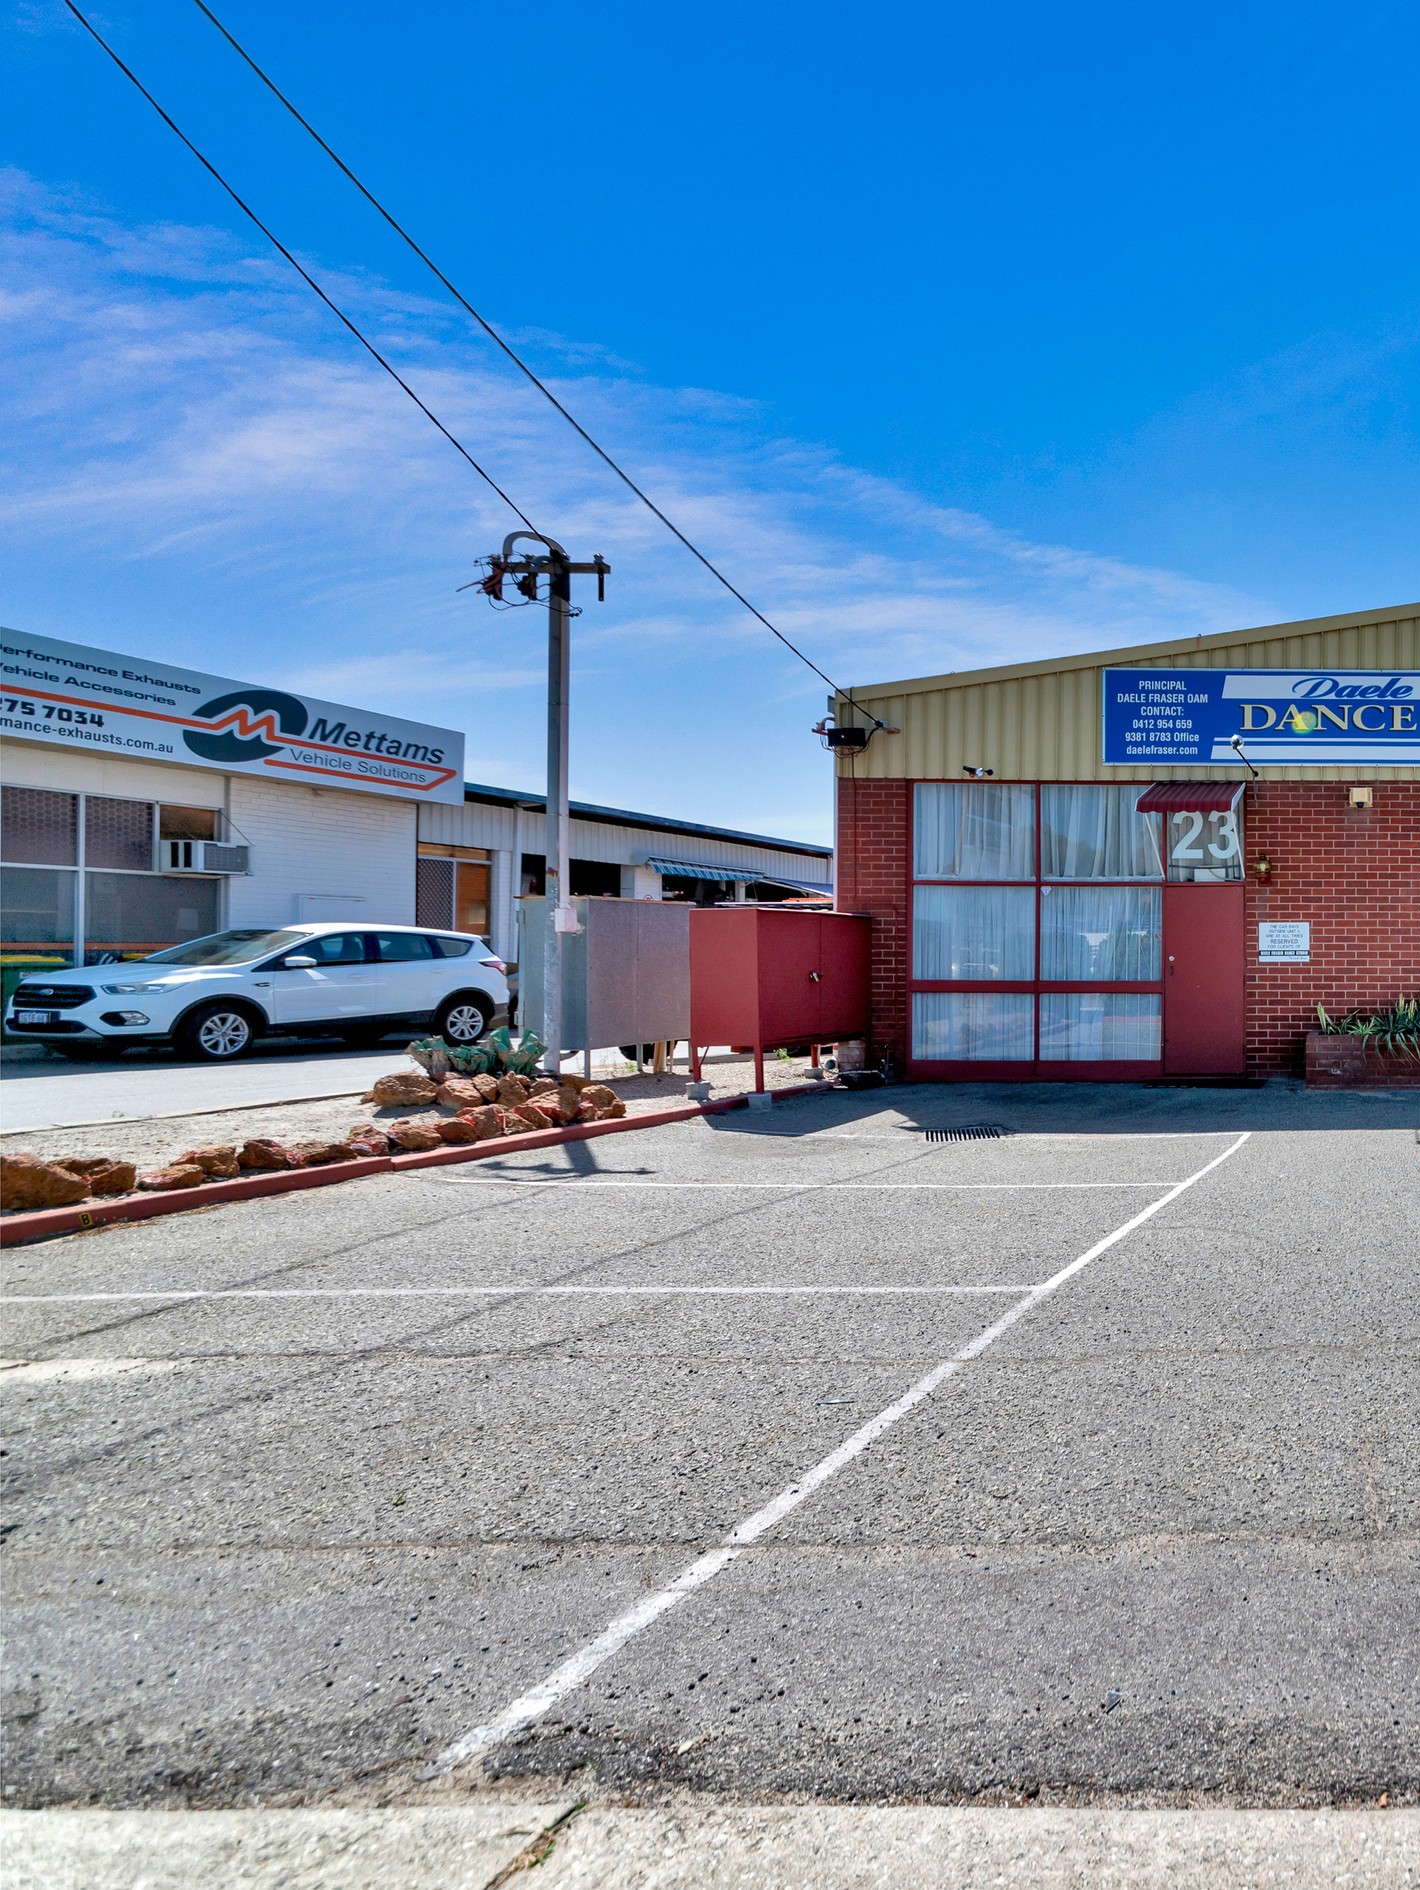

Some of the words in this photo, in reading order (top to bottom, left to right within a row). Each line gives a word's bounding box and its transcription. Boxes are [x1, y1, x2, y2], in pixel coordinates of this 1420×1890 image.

[64, 676, 177, 706] Accessories
[122, 670, 202, 695] Exhausts
[1138, 680, 1187, 691] PRINCIPAL
[1292, 677, 1414, 699] Daele
[1117, 693, 1146, 703] DAELE
[1148, 693, 1185, 703] FRASER
[1187, 694, 1209, 703] OAM
[42, 704, 105, 728] 7034
[1140, 706, 1185, 716] CONTACT:
[1240, 704, 1417, 731] DANCE
[1132, 719, 1155, 729] 0412
[1157, 719, 1174, 729] 954
[1175, 719, 1193, 729] 659
[308, 717, 446, 765] Mettams
[1125, 732, 1146, 742] 9381
[1149, 732, 1171, 742] 8783
[1173, 732, 1200, 742] Office
[1126, 745, 1198, 755] daelefraser.com
[289, 747, 353, 771] Vehicle
[357, 761, 427, 783] Solutions
[1172, 811, 1238, 859] 23
